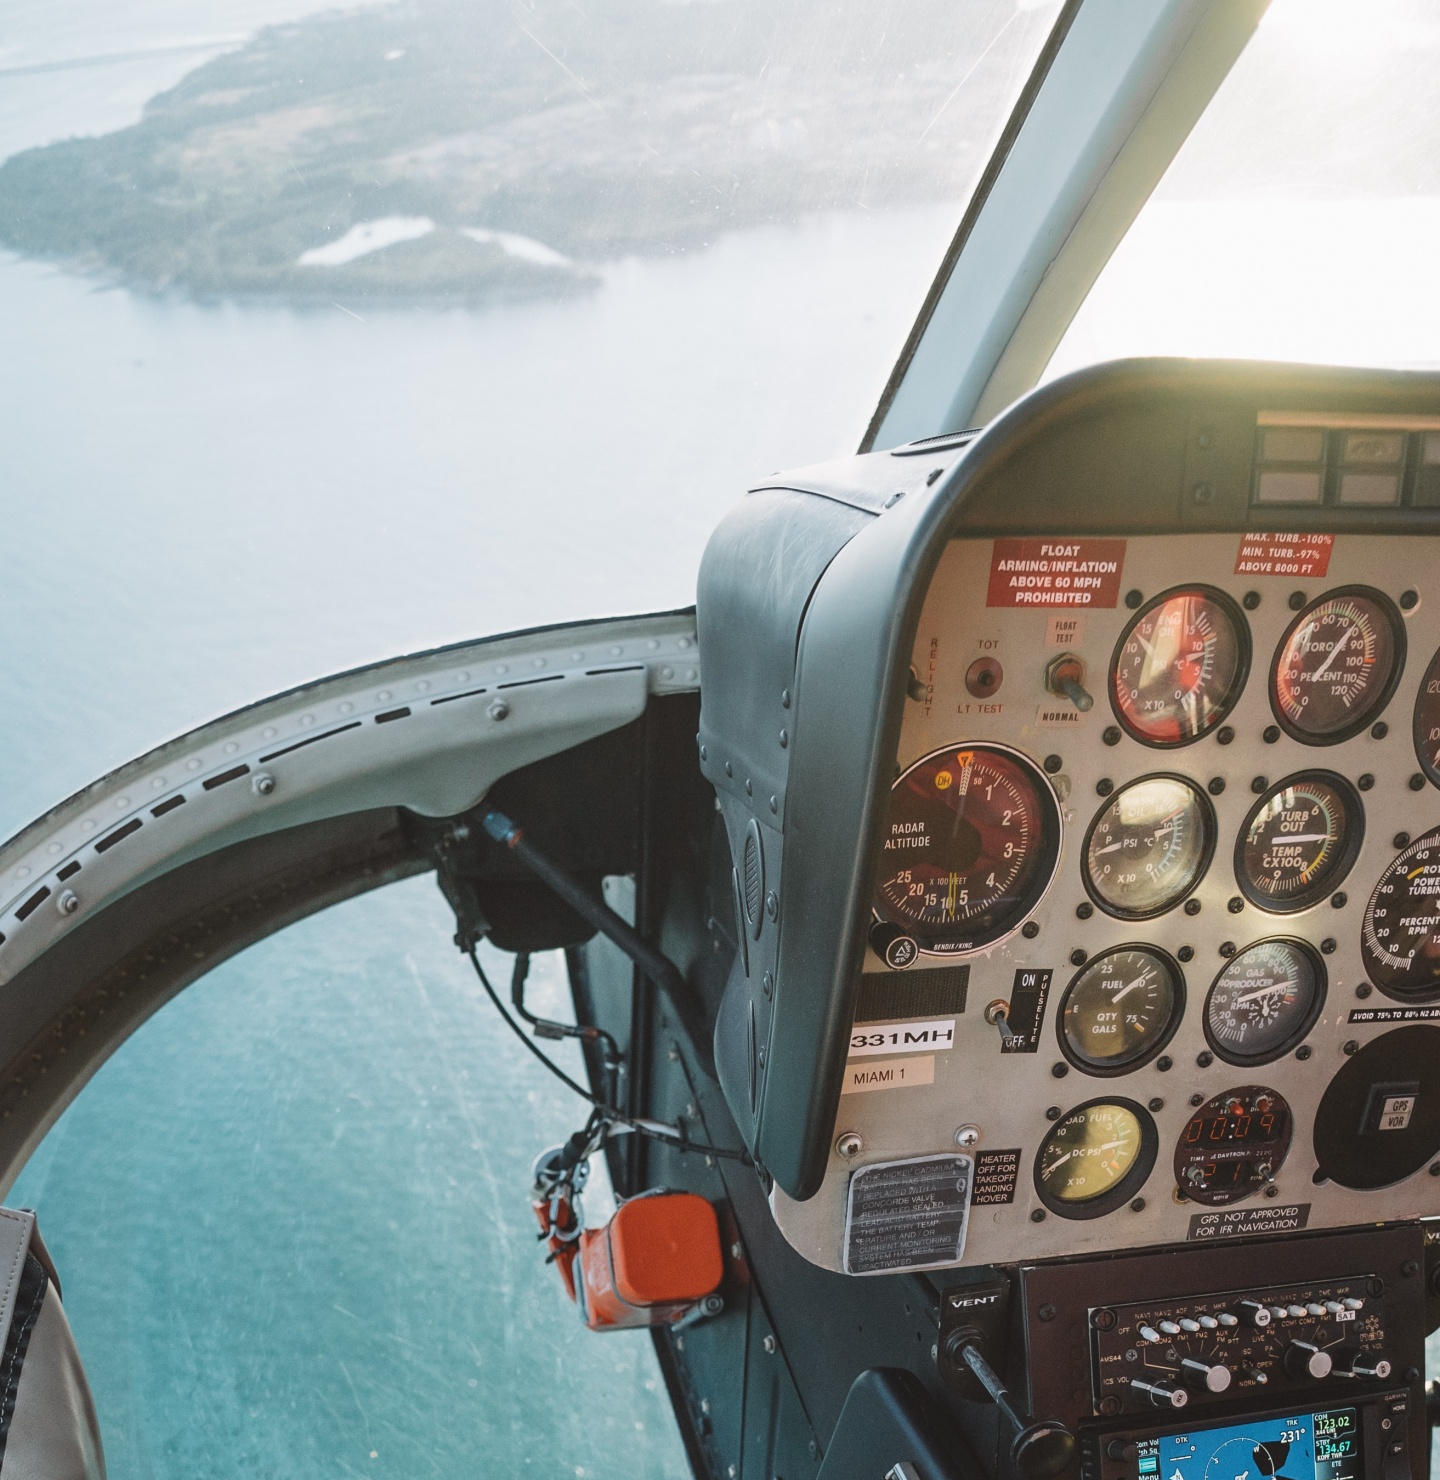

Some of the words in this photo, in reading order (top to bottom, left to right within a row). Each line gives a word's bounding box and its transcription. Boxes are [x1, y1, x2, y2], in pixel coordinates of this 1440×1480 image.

[1245, 533, 1270, 541] MAX.
[1040, 545, 1080, 556] FLOAT
[1241, 547, 1264, 556] MIN.
[1269, 548, 1320, 559] TURB.-97%
[998, 561, 1117, 573] ARMING/INFLATION
[1239, 562, 1272, 572] ABOVE
[1275, 564, 1298, 573] 8000
[1301, 565, 1313, 573] FT
[1009, 577, 1052, 587] ABOVE
[1055, 578, 1071, 587] 60
[1073, 578, 1101, 588] MPH
[1015, 592, 1091, 603] PROHIBITED
[1055, 622, 1077, 631] FLOAT
[1056, 634, 1074, 643] TEST
[978, 641, 999, 650] TOT
[1346, 657, 1364, 666] 100
[1343, 674, 1357, 683] 110
[1331, 686, 1347, 695] 120
[958, 705, 970, 714] LT
[978, 705, 1003, 714] TEST
[1042, 713, 1079, 721] NORMAL
[1002, 810, 1012, 826] 2
[1280, 811, 1309, 821] TURB
[892, 822, 925, 835] RADAR
[1280, 822, 1305, 832] OUT
[884, 836, 931, 850] ALTITUDE
[1123, 839, 1137, 848] PSI
[1004, 843, 1013, 858] 3
[1272, 847, 1302, 857] TEMP
[897, 871, 912, 883] 25
[986, 872, 995, 888] 4
[909, 883, 924, 896] 20
[924, 894, 937, 906] 15
[960, 890, 968, 905] 5
[1399, 917, 1440, 926] PERCENT
[1408, 927, 1428, 935] RPM
[1101, 965, 1113, 974] 25
[1246, 969, 1265, 977] GAS
[1022, 974, 1036, 986] ON
[1102, 980, 1123, 989] FUEL
[1229, 979, 1274, 988] PRODUCER
[1031, 975, 1049, 1042] PULSELITE
[1097, 1013, 1117, 1022] QTY
[1126, 1015, 1137, 1023] 75
[1092, 1025, 1117, 1033] GALS
[851, 1029, 953, 1048] 331MH
[854, 1070, 894, 1085] MIAMI
[900, 1068, 904, 1079] 1
[1393, 1101, 1408, 1112] GPS
[1090, 1114, 1113, 1122] FUEL
[1388, 1117, 1404, 1127] VOR
[1187, 1114, 1274, 1142] 00:09
[981, 1155, 1016, 1164] HEATER
[978, 1166, 996, 1174] OFF
[976, 1174, 1015, 1184] TAKEOFF
[974, 1184, 1013, 1194] LANDING
[863, 1198, 909, 1210] CONCORDE
[911, 1193, 936, 1203] VALVE
[977, 1194, 1007, 1203] HOVER
[913, 1201, 944, 1212] SEALED
[1201, 1215, 1219, 1225] GPS
[1224, 1212, 1246, 1222] NOT
[1250, 1208, 1298, 1219] APPROVED
[879, 1223, 914, 1233] BATTERY
[1196, 1228, 1215, 1236] FOR
[1220, 1225, 1233, 1234] IFR
[1237, 1219, 1298, 1232] NAVIGATION
[901, 1236, 951, 1248] MONITORING
[858, 1259, 911, 1271] DEACTIVATED
[952, 1295, 998, 1308] VENT
[1337, 1312, 1353, 1320] SAT
[1385, 1393, 1407, 1401] GARMIN
[1319, 1416, 1350, 1430] 123.02
[1280, 1428, 1306, 1444] 231°
[1316, 1439, 1330, 1447] STBY
[1320, 1441, 1351, 1455] 134.67
[1332, 1460, 1342, 1468] ETE
